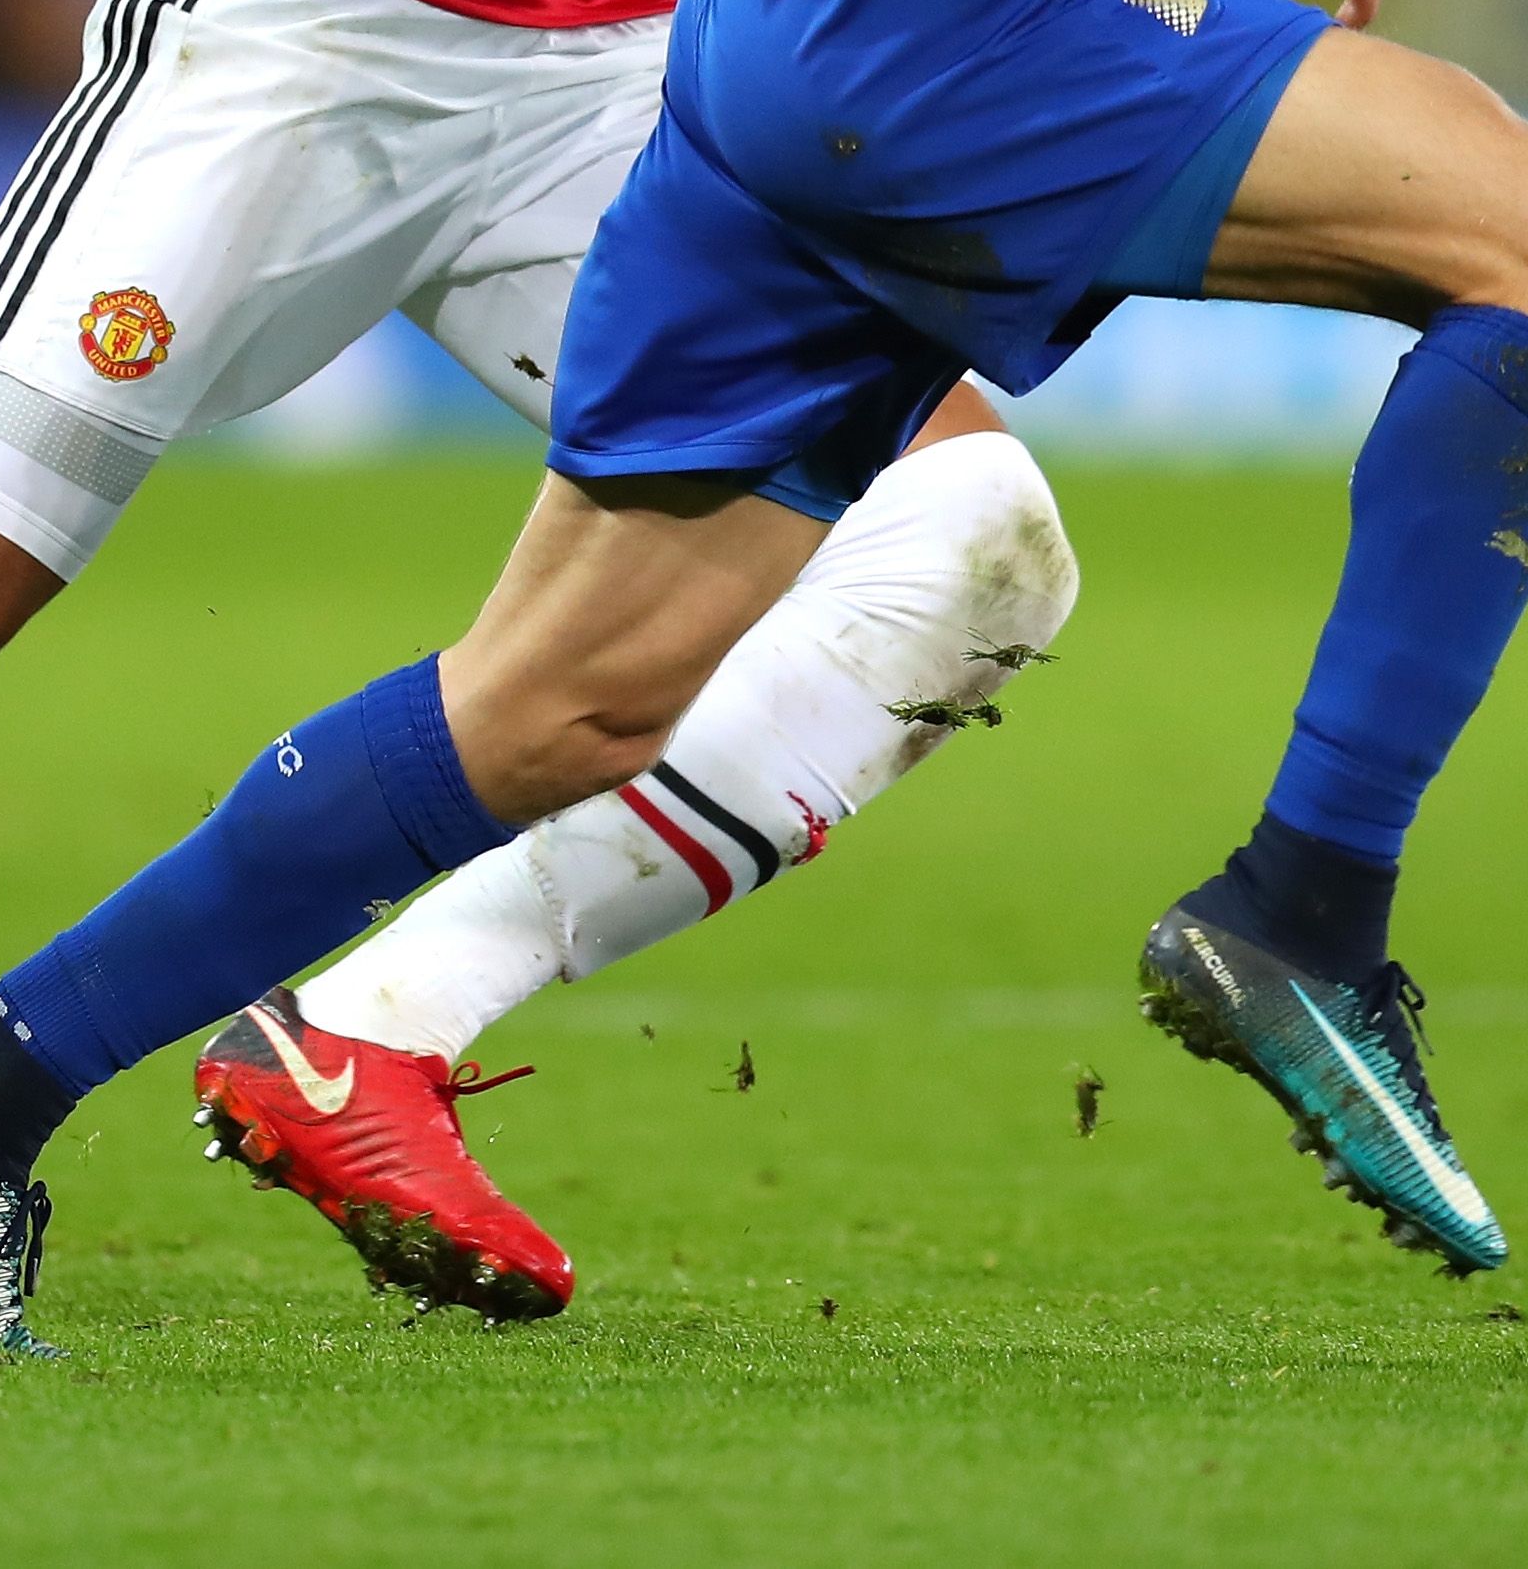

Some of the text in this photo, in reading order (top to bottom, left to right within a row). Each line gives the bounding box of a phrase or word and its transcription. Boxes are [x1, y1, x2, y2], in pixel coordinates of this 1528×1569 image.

[96, 293, 167, 339] MANCHESTER
[87, 347, 138, 377] UNITED
[1181, 927, 1248, 1010] MERCURIAL
